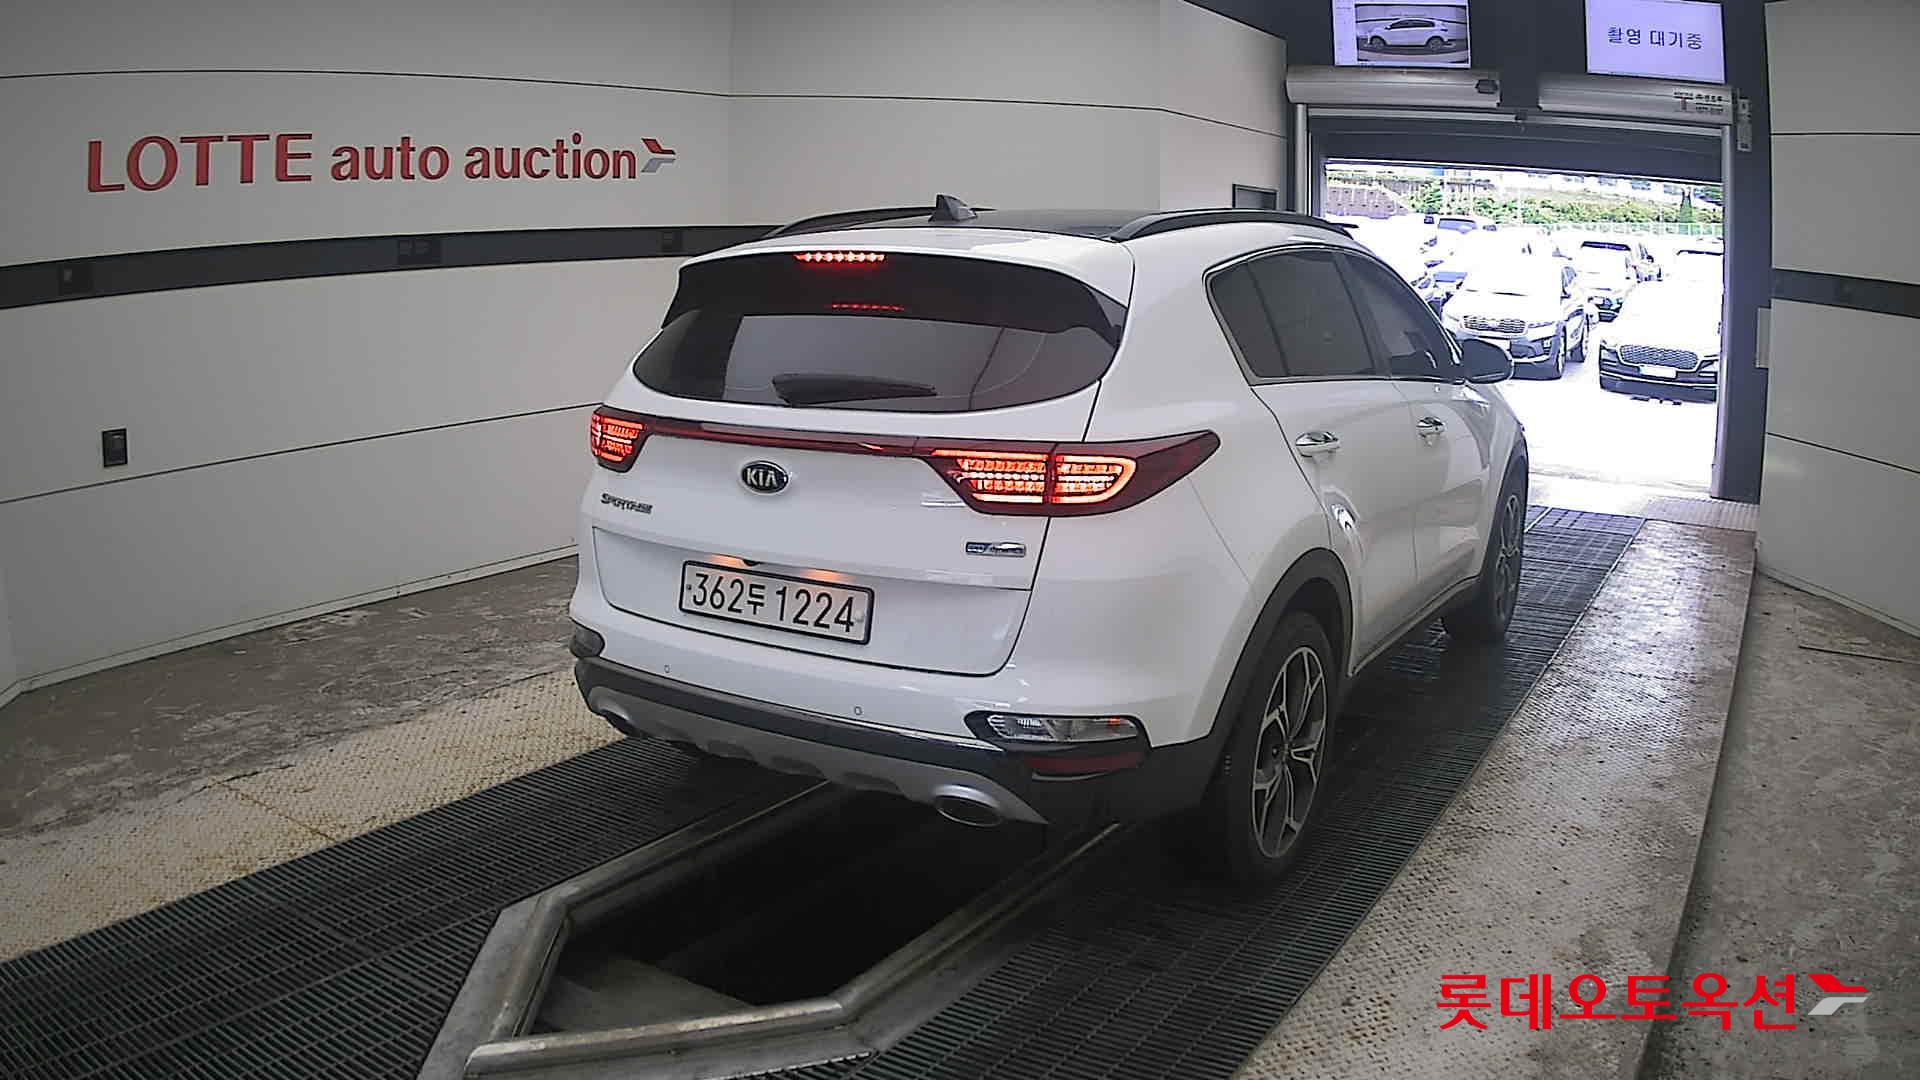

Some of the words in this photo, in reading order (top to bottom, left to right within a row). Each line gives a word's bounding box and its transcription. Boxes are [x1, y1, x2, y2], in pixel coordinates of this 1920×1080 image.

[1608, 26, 1641, 46] 촬영
[1649, 30, 1703, 50] 대기중
[87, 133, 312, 192] LOTTE
[331, 136, 450, 181] auto
[464, 132, 637, 181] auction
[746, 467, 779, 488] KIA
[692, 573, 766, 615] 362두
[776, 586, 855, 633] 1224
